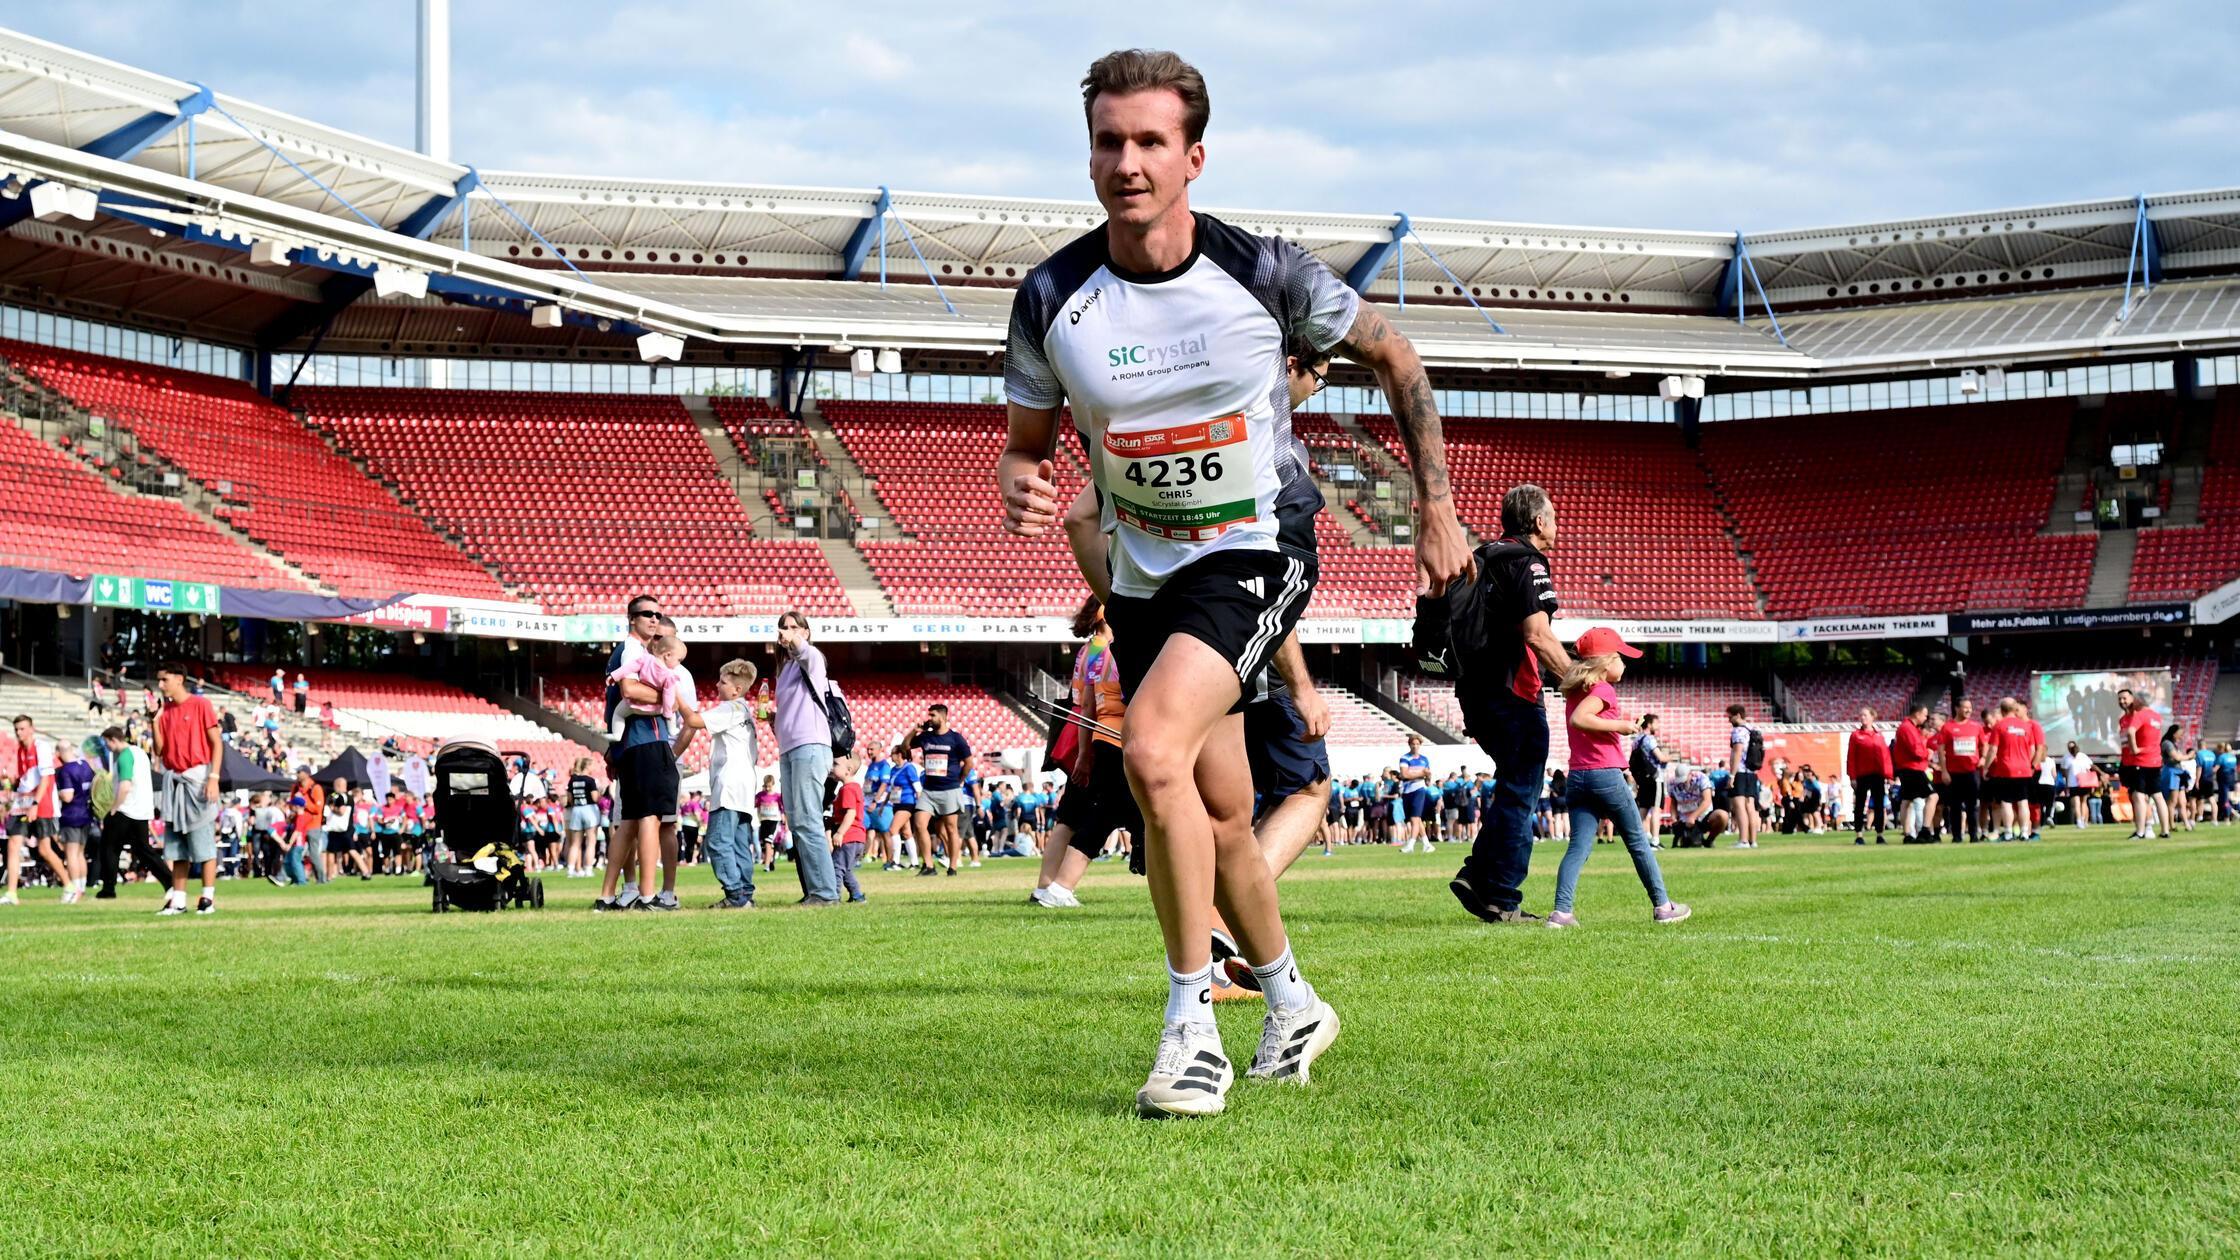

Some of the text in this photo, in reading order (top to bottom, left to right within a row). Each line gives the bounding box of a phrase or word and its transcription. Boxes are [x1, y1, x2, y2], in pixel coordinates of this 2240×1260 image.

[1080, 288, 1102, 313] artiva
[1108, 333, 1207, 368] SiCrystal
[1120, 371, 1145, 381] ROHM
[1147, 367, 1172, 377] Group
[1173, 360, 1210, 372] Company
[1125, 452, 1223, 488] 4236
[1158, 489, 1193, 500] CHRIS
[1181, 499, 1203, 507] GmbH
[1140, 509, 1179, 521] STARTZEIT
[1181, 512, 1204, 521] 18:45
[1206, 511, 1221, 519] Uhr
[145, 584, 172, 604] WC
[516, 620, 558, 632] PLAST
[678, 624, 724, 633] AST
[821, 624, 889, 633] PLAST
[982, 624, 1047, 633] PLAST
[1813, 620, 1936, 632] FACKELMANN THERME
[1971, 618, 1995, 629] Mehr
[1316, 626, 1355, 634] THERME
[1689, 626, 1725, 634] THERME
